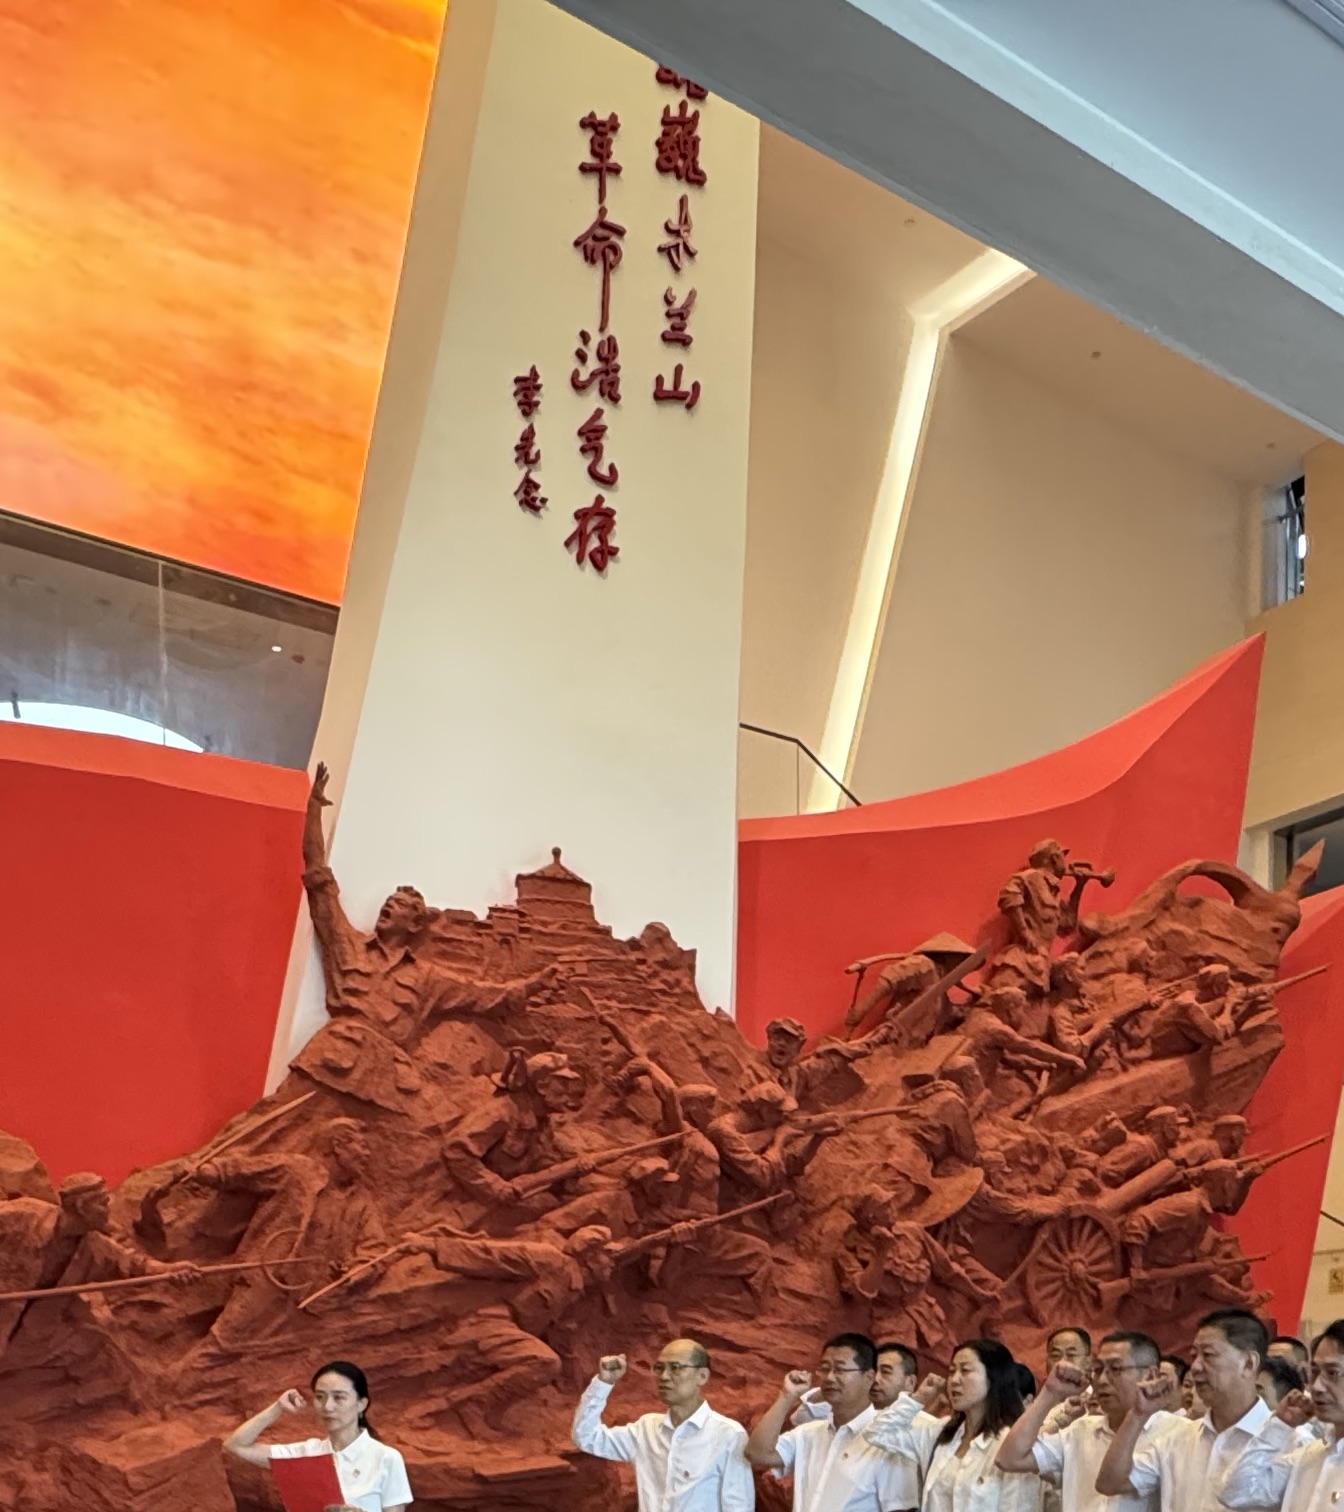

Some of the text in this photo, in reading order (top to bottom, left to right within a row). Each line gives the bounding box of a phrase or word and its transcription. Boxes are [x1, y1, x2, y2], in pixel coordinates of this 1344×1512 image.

[513, 365, 548, 516] 李先念
[564, 110, 626, 573] 革命浩气存
